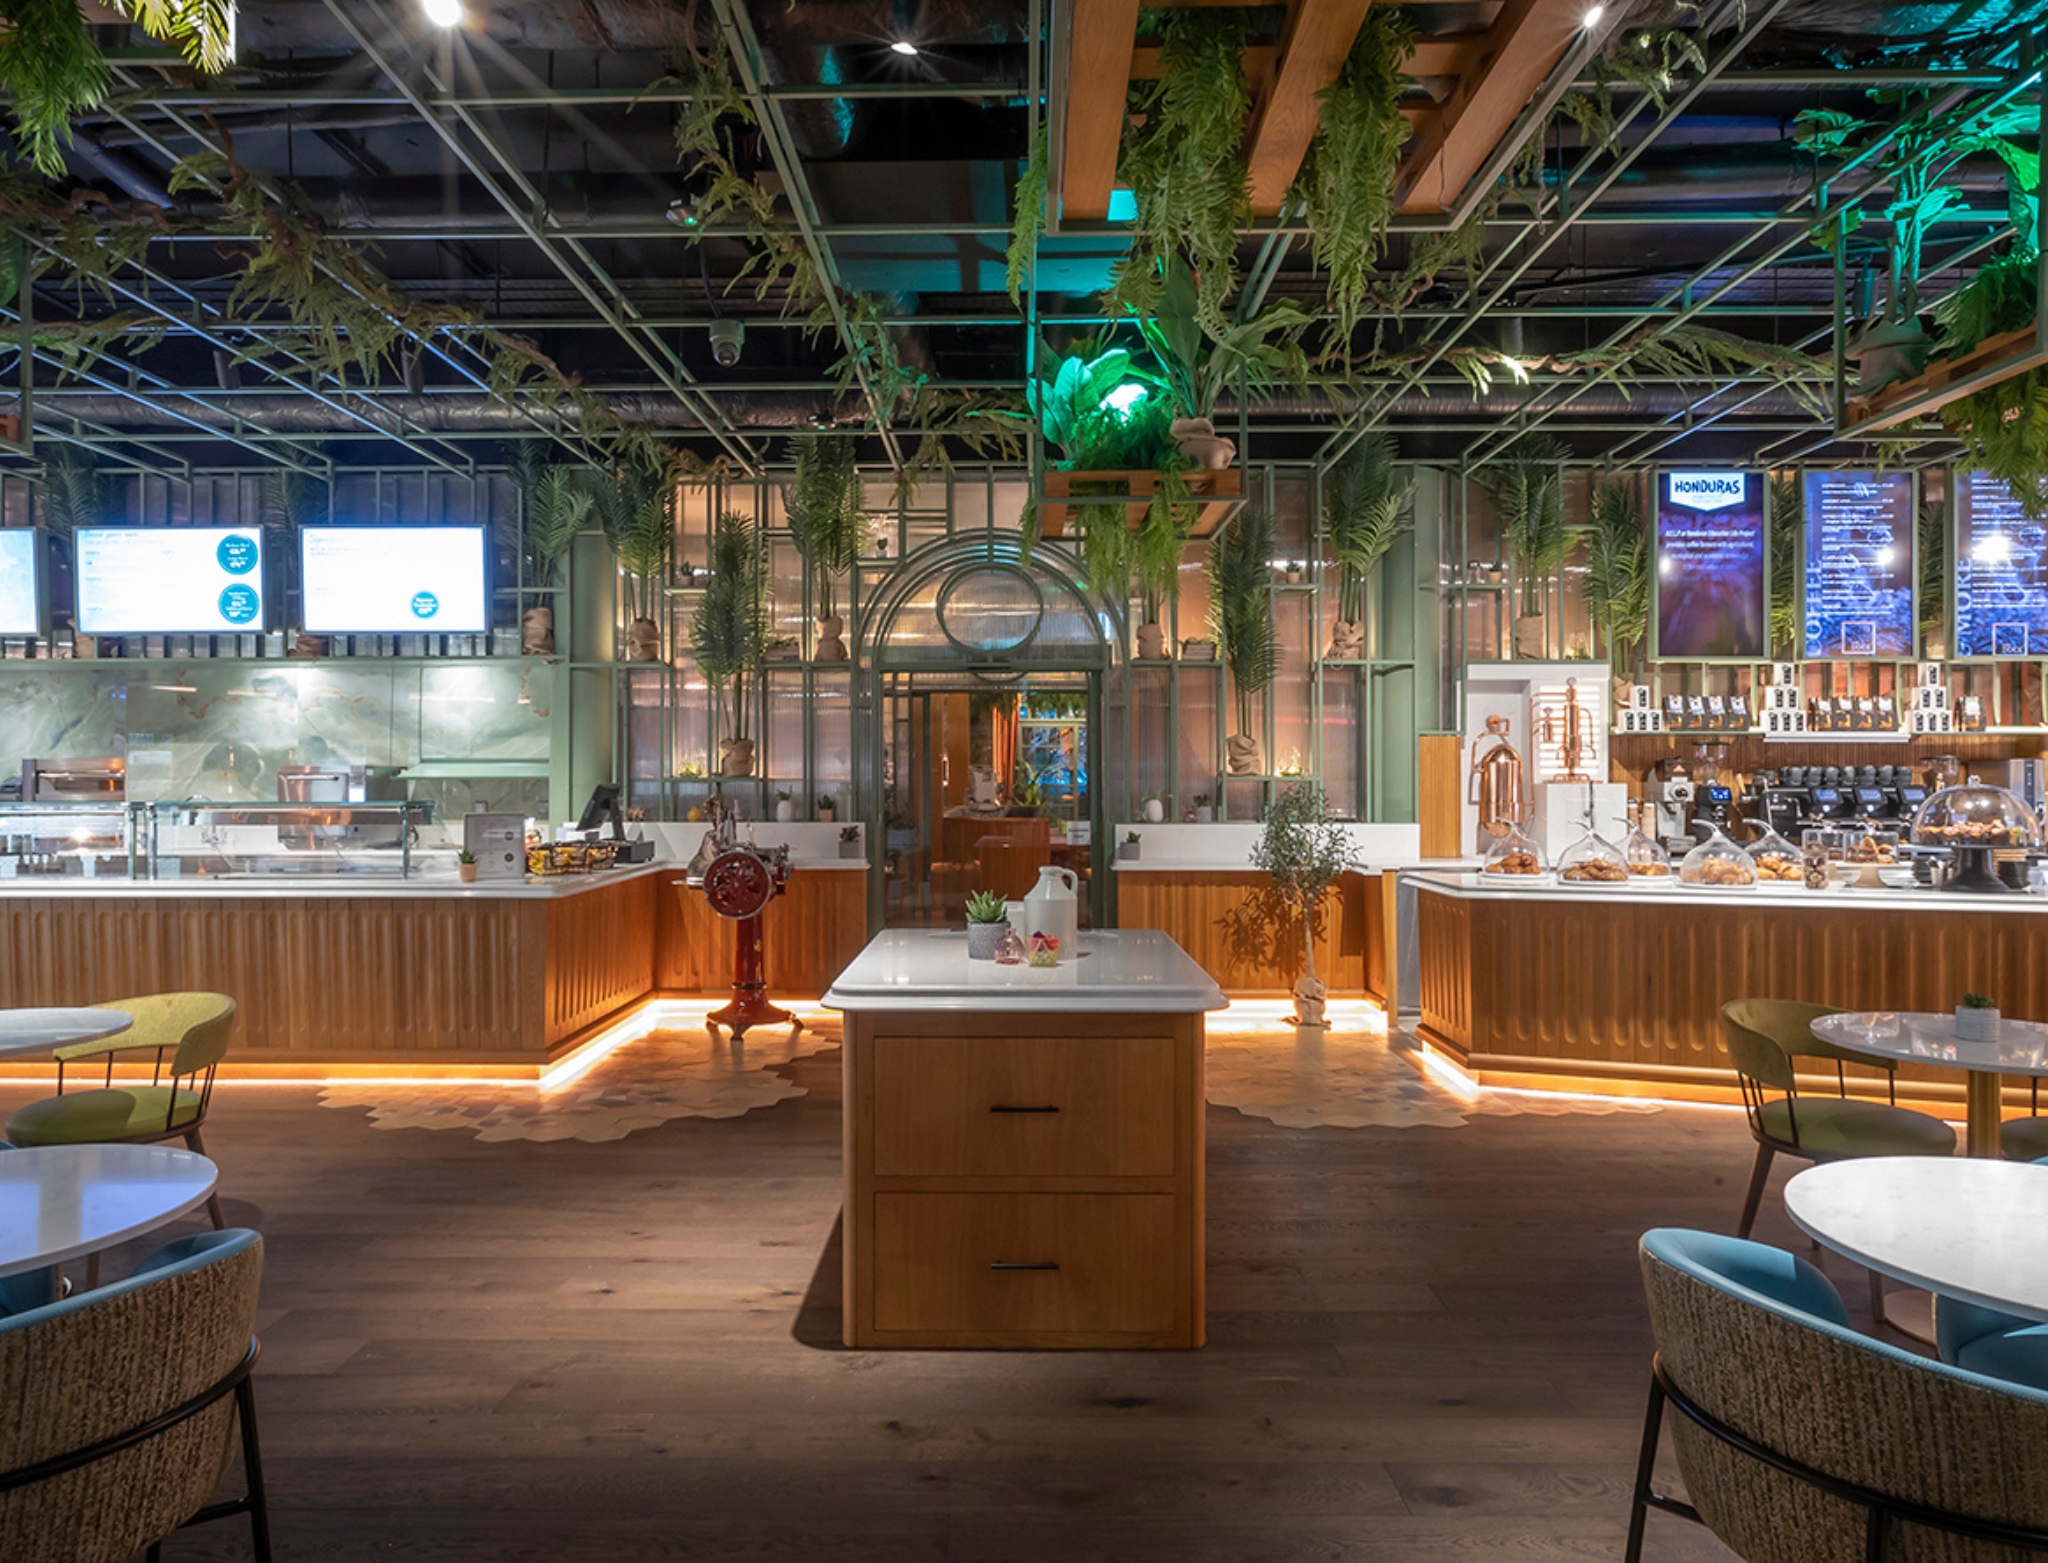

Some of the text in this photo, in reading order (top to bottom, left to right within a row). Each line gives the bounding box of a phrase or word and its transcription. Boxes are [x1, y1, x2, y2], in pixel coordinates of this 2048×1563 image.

[1674, 479, 1741, 495] HONDURAS
[1806, 555, 1822, 657] COFFEE
[1958, 557, 1973, 636] MORE
